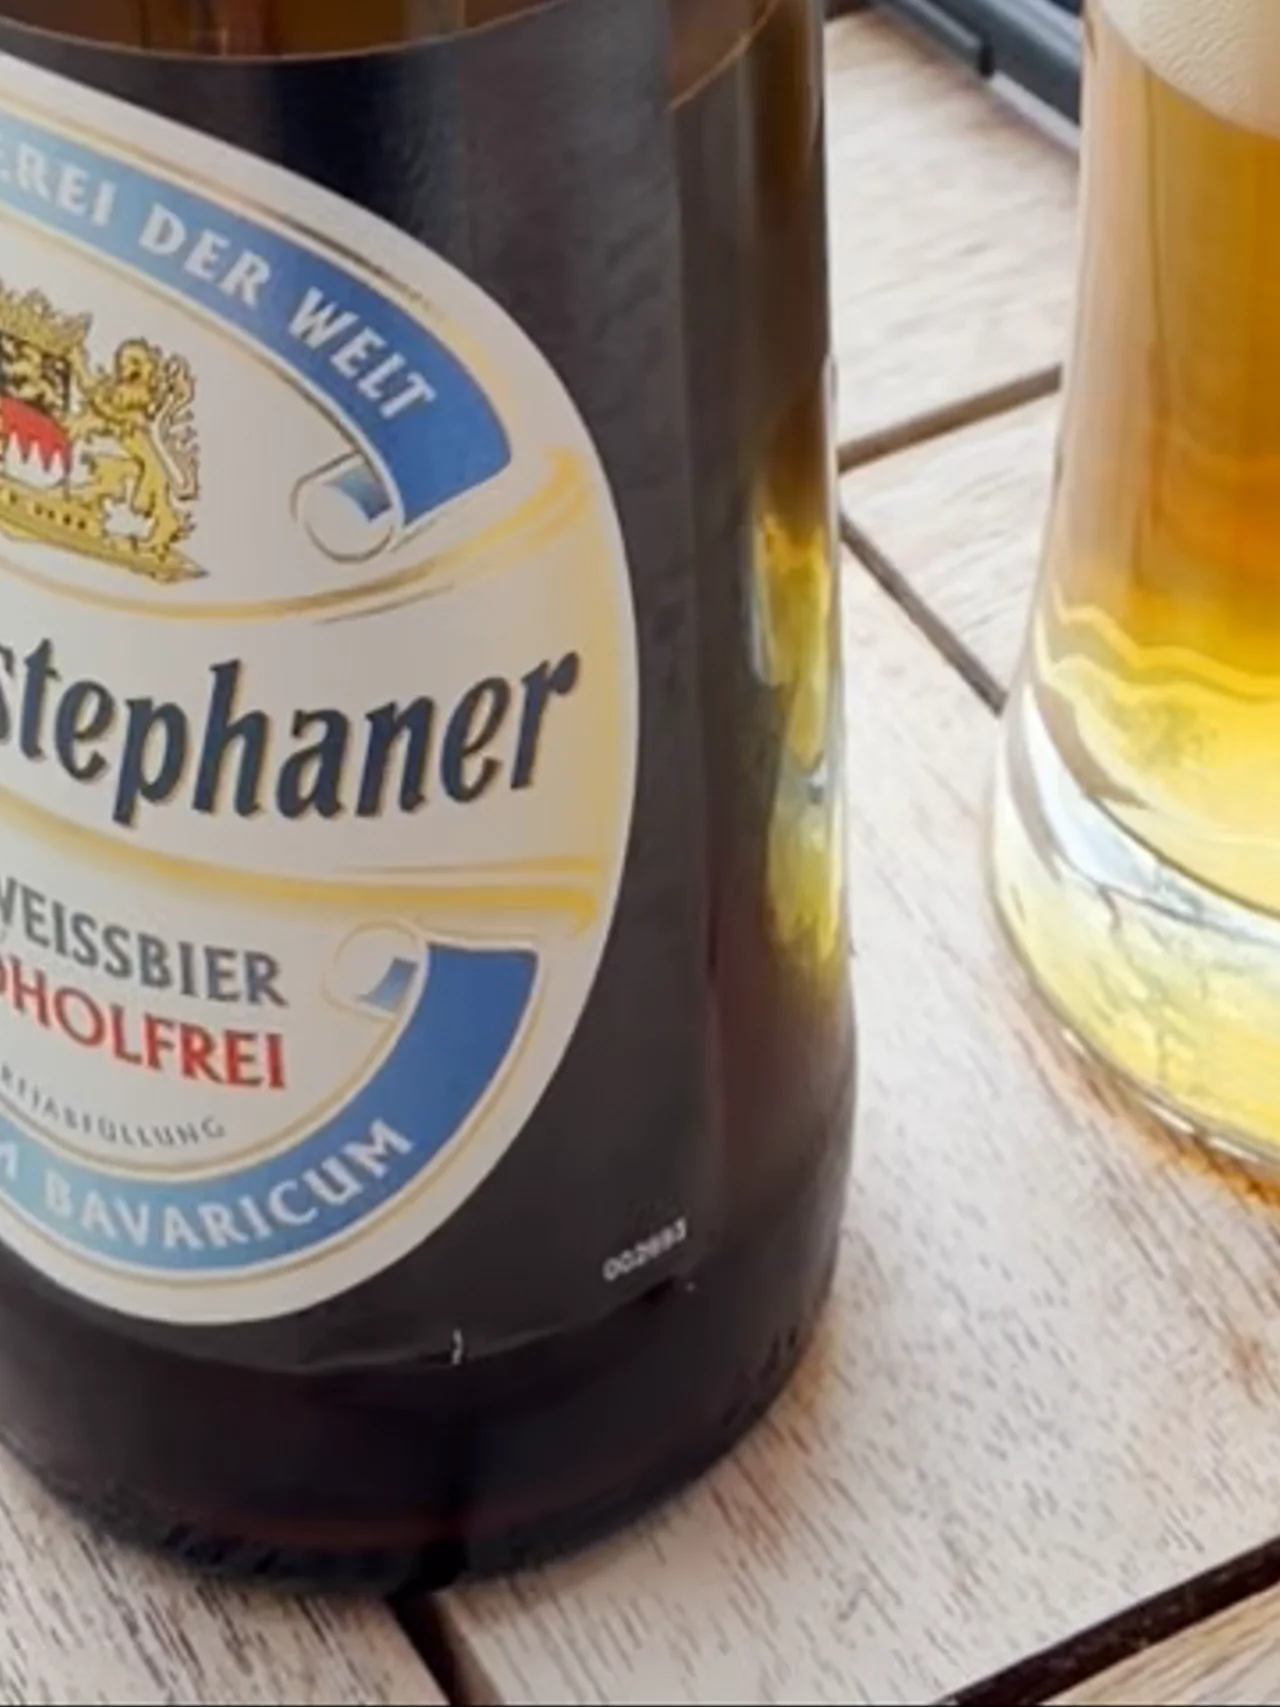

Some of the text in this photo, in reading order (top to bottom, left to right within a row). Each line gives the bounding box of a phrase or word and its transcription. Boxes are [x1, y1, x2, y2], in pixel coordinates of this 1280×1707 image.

[138, 201, 272, 310] DER
[288, 285, 438, 421] WELT
[44, 1117, 414, 1251] BAVARICUM
